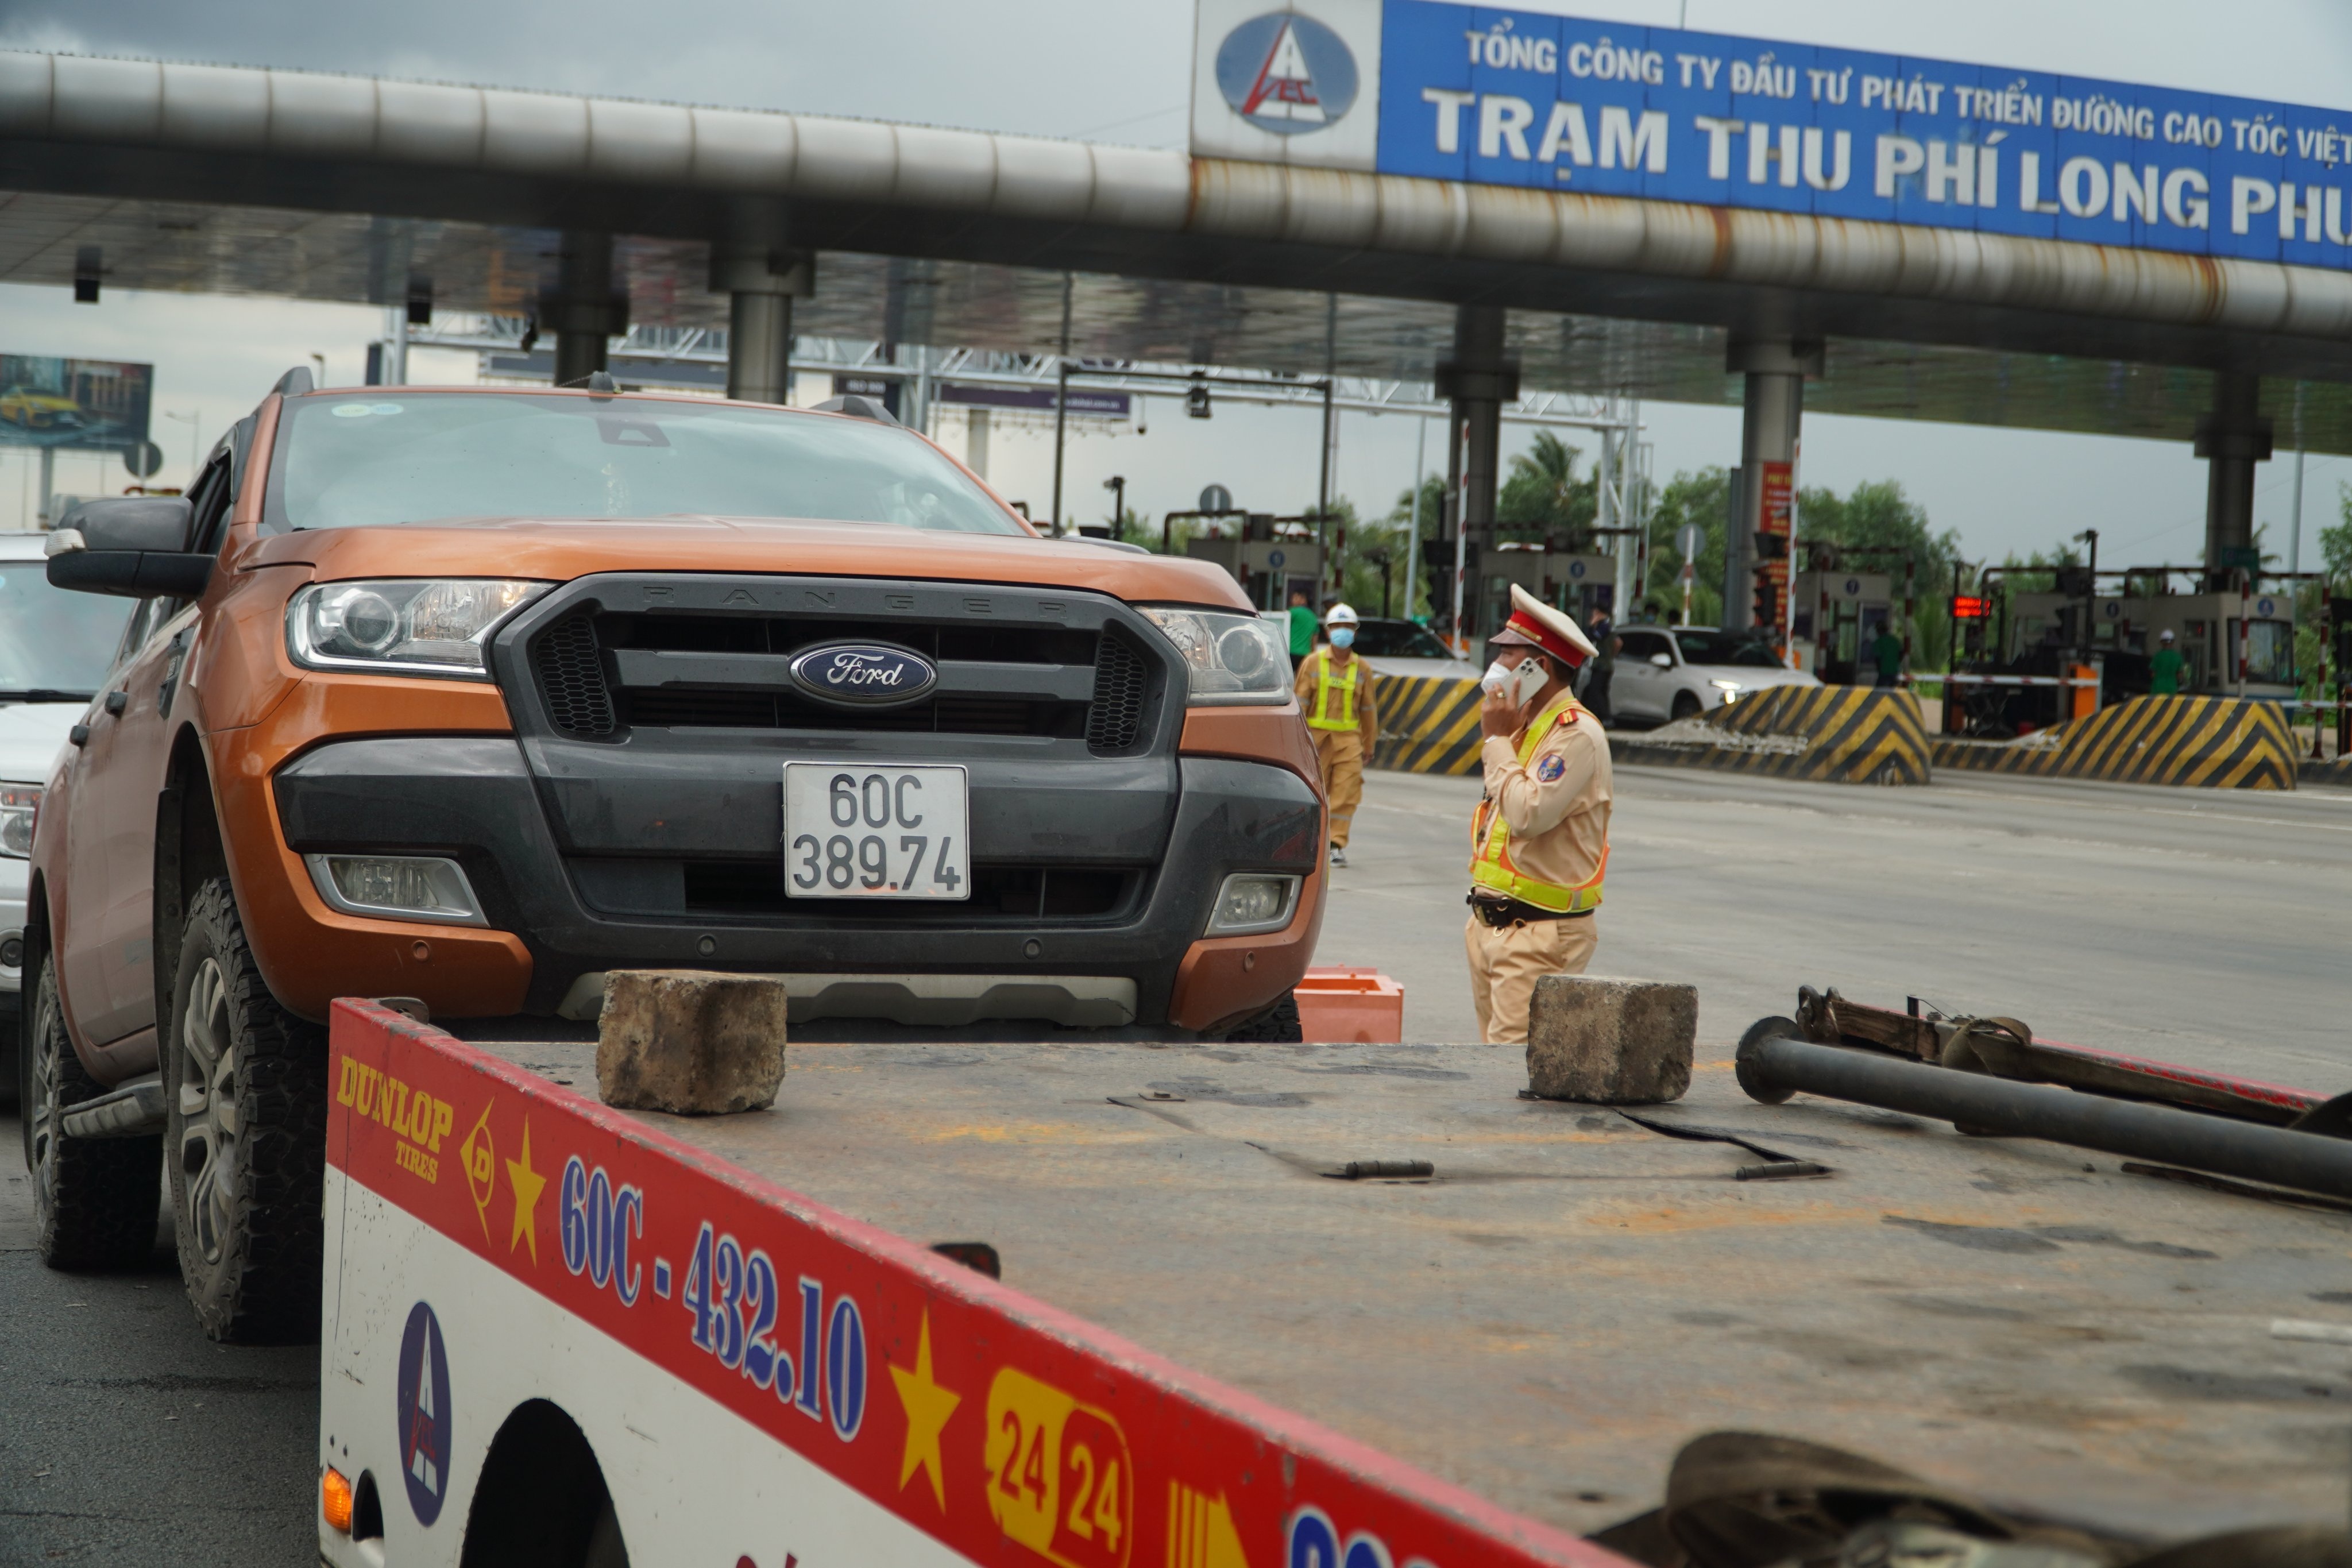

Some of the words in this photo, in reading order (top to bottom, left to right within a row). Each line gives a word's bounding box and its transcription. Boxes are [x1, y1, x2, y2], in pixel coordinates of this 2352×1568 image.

[1464, 16, 1558, 74] TỔNG
[1567, 36, 1664, 85] CÔNG
[1675, 53, 1722, 90] TY
[1806, 66, 1853, 105] TƯ
[1860, 72, 1944, 115] PHÁT
[1954, 76, 2044, 126] TRIỂN
[2050, 93, 2155, 141] ĐƯỜNG
[2162, 110, 2223, 149] CAO
[2231, 113, 2289, 157] TỐC
[1422, 87, 1669, 180] TRẠM
[1694, 115, 1852, 191] THU
[1874, 130, 2008, 209] PHÍ
[2019, 151, 2210, 230] LONG
[643, 586, 1068, 621] RANGER
[827, 653, 903, 686] Ford
[830, 773, 922, 829] 60C
[793, 834, 961, 891] 389.74
[337, 1055, 454, 1154] DUNLOP
[395, 1140, 439, 1184] TIRES
[561, 1154, 643, 1308] 60C
[683, 1220, 866, 1443] 432.10
[999, 1410, 1048, 1514] 24
[1068, 1443, 1122, 1554] 24
